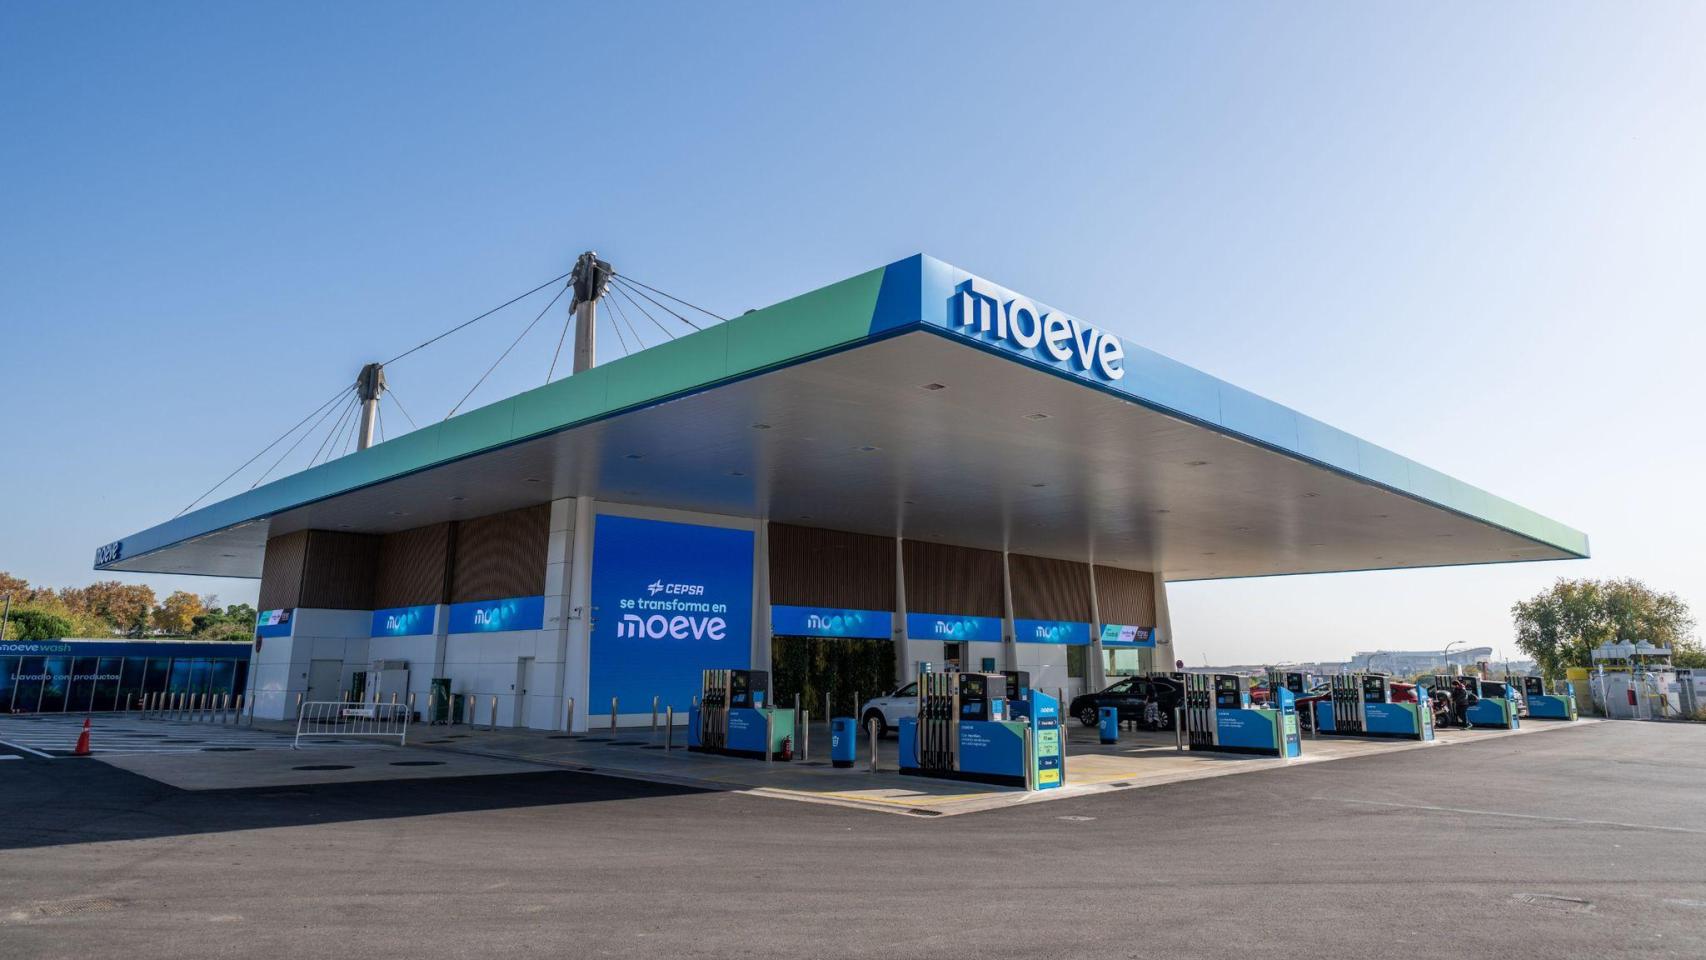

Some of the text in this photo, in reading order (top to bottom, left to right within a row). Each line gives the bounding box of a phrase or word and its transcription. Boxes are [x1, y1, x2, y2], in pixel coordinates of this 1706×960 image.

[958, 279, 1125, 380] moeve
[665, 583, 704, 596] CEPSA
[619, 597, 727, 613] se transforma en
[387, 610, 420, 630] moe
[474, 603, 516, 625] moe
[617, 614, 727, 640] moeve
[807, 614, 863, 631] moe
[935, 620, 979, 635] moe
[1036, 625, 1072, 639] moe
[40, 643, 71, 652] wash
[73, 673, 120, 682] productos
